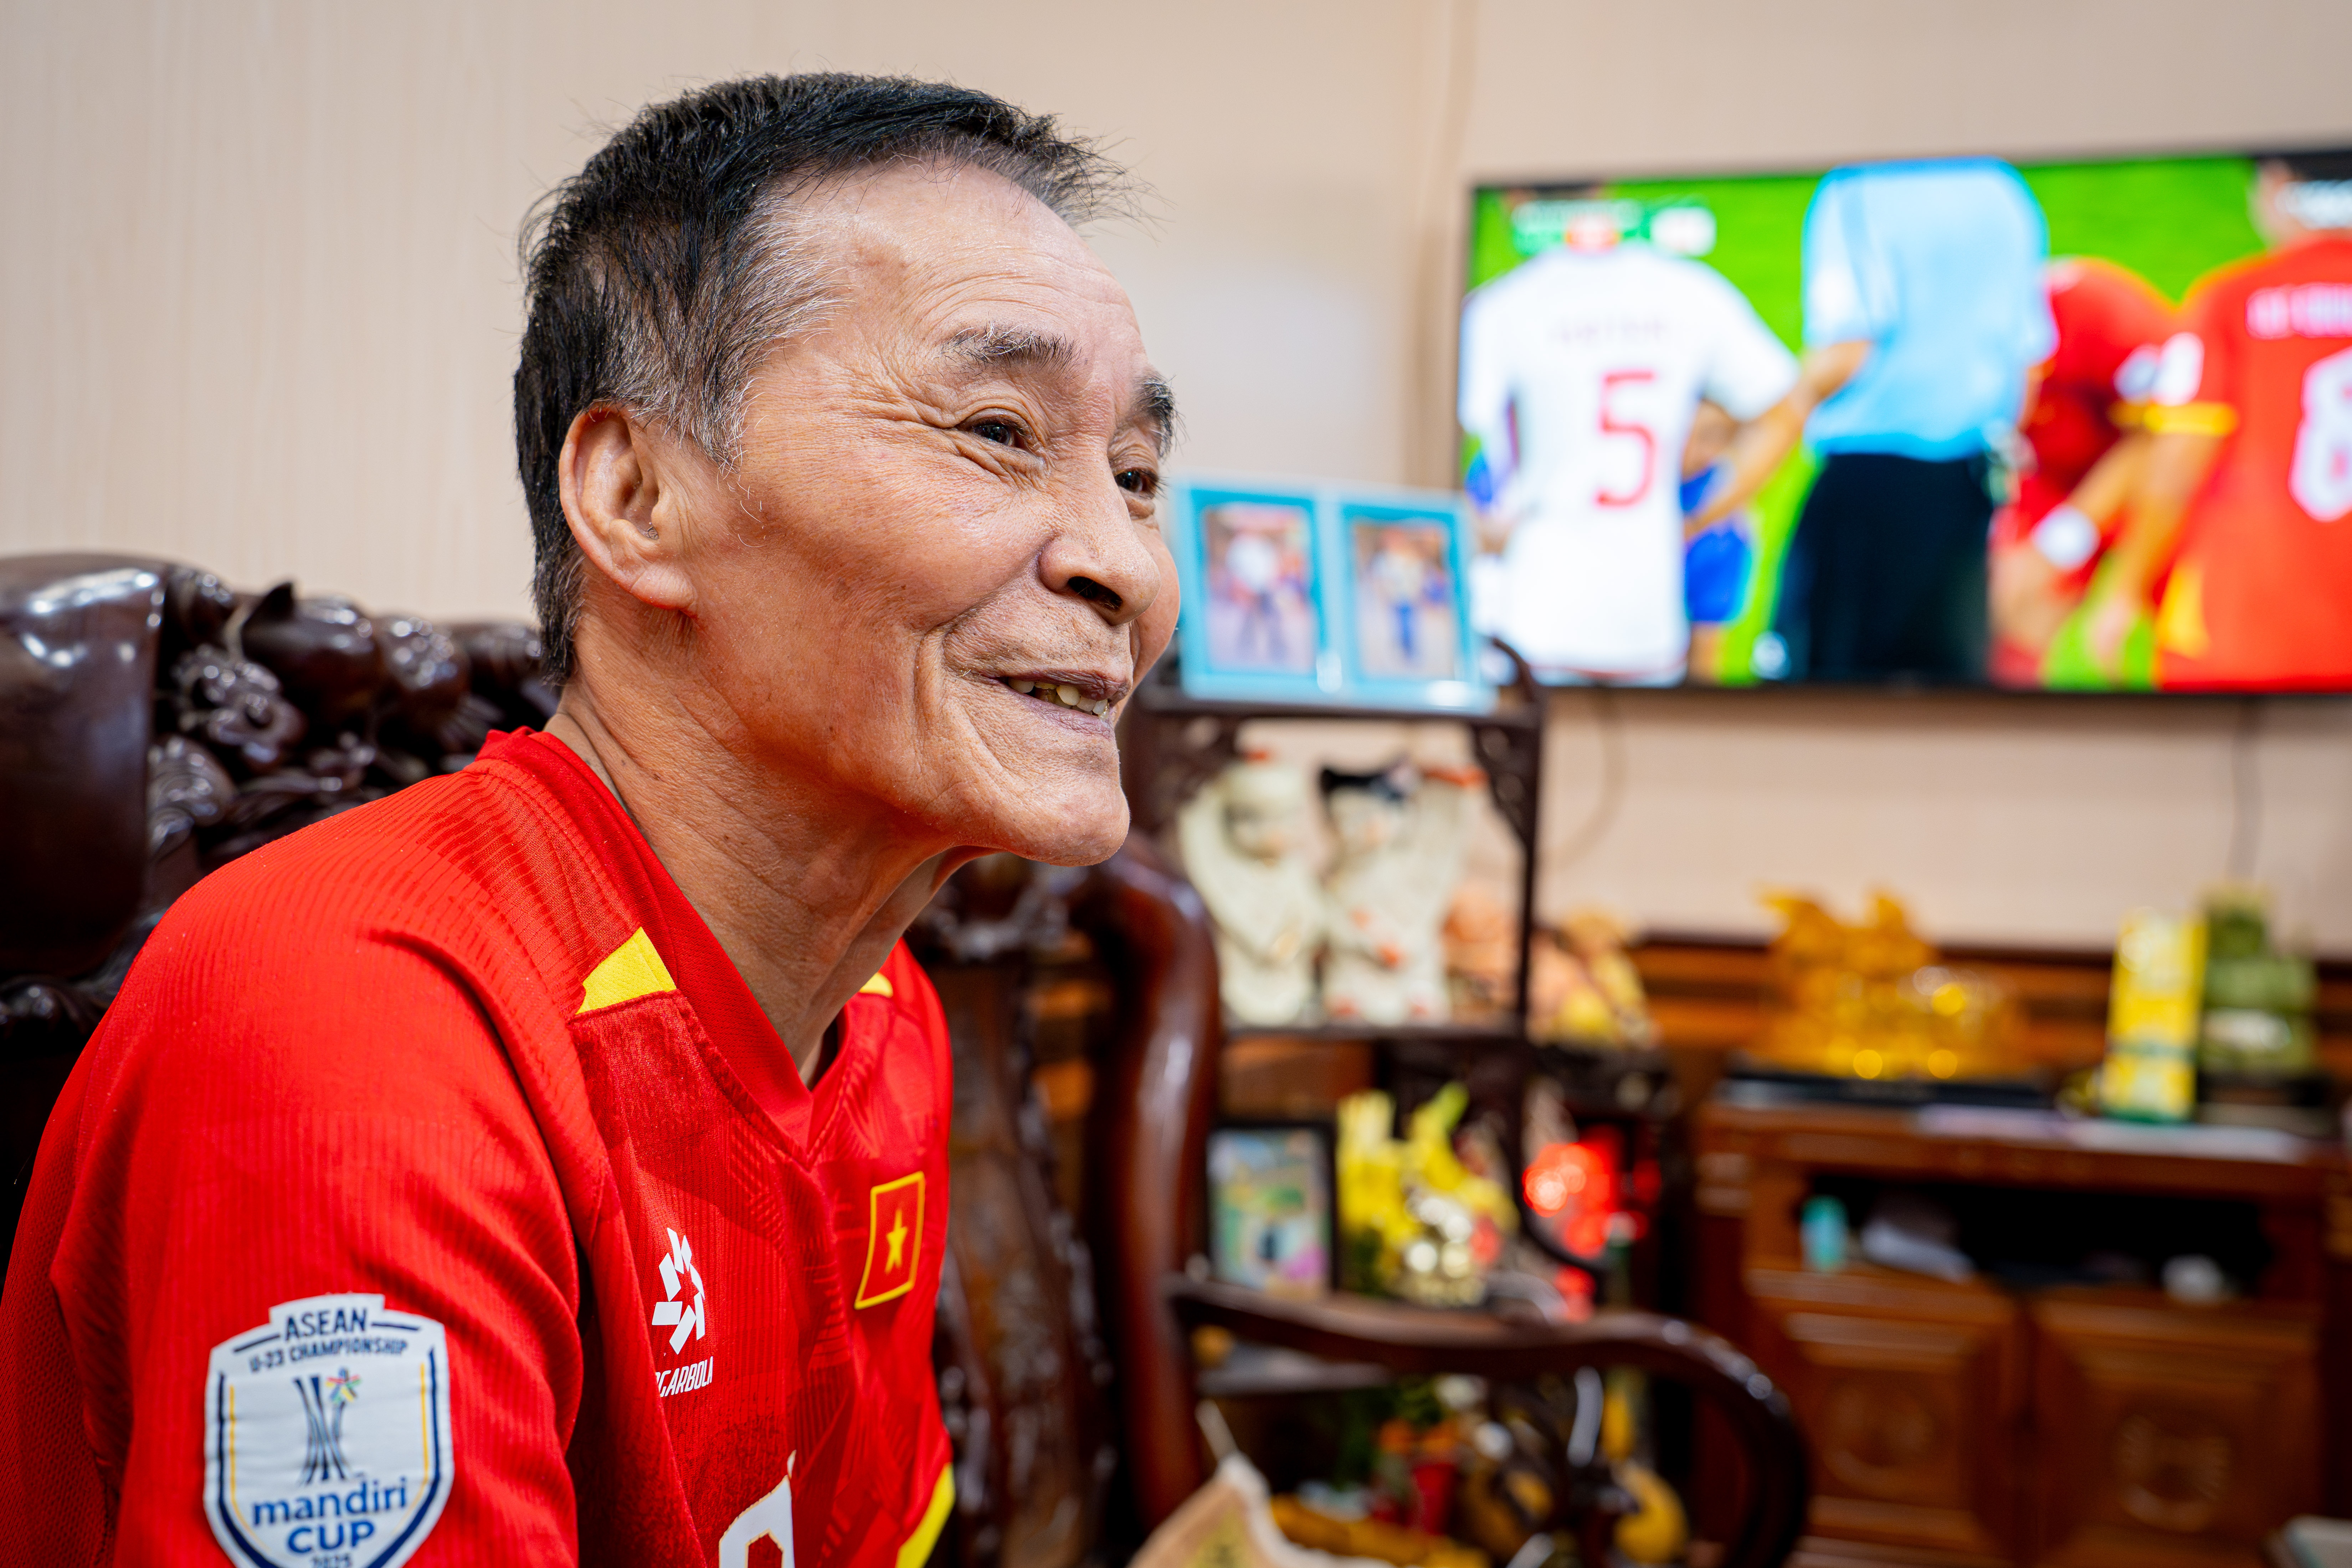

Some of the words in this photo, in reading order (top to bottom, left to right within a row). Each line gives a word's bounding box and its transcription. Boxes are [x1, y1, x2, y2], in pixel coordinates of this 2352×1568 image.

[1593, 369, 1657, 508] 5
[286, 1308, 367, 1341] ASEAN
[250, 1349, 284, 1372] U-23
[290, 1336, 407, 1362] CHAMPIONSHIP
[253, 1476, 407, 1525] mandiri
[288, 1521, 374, 1553] CUP
